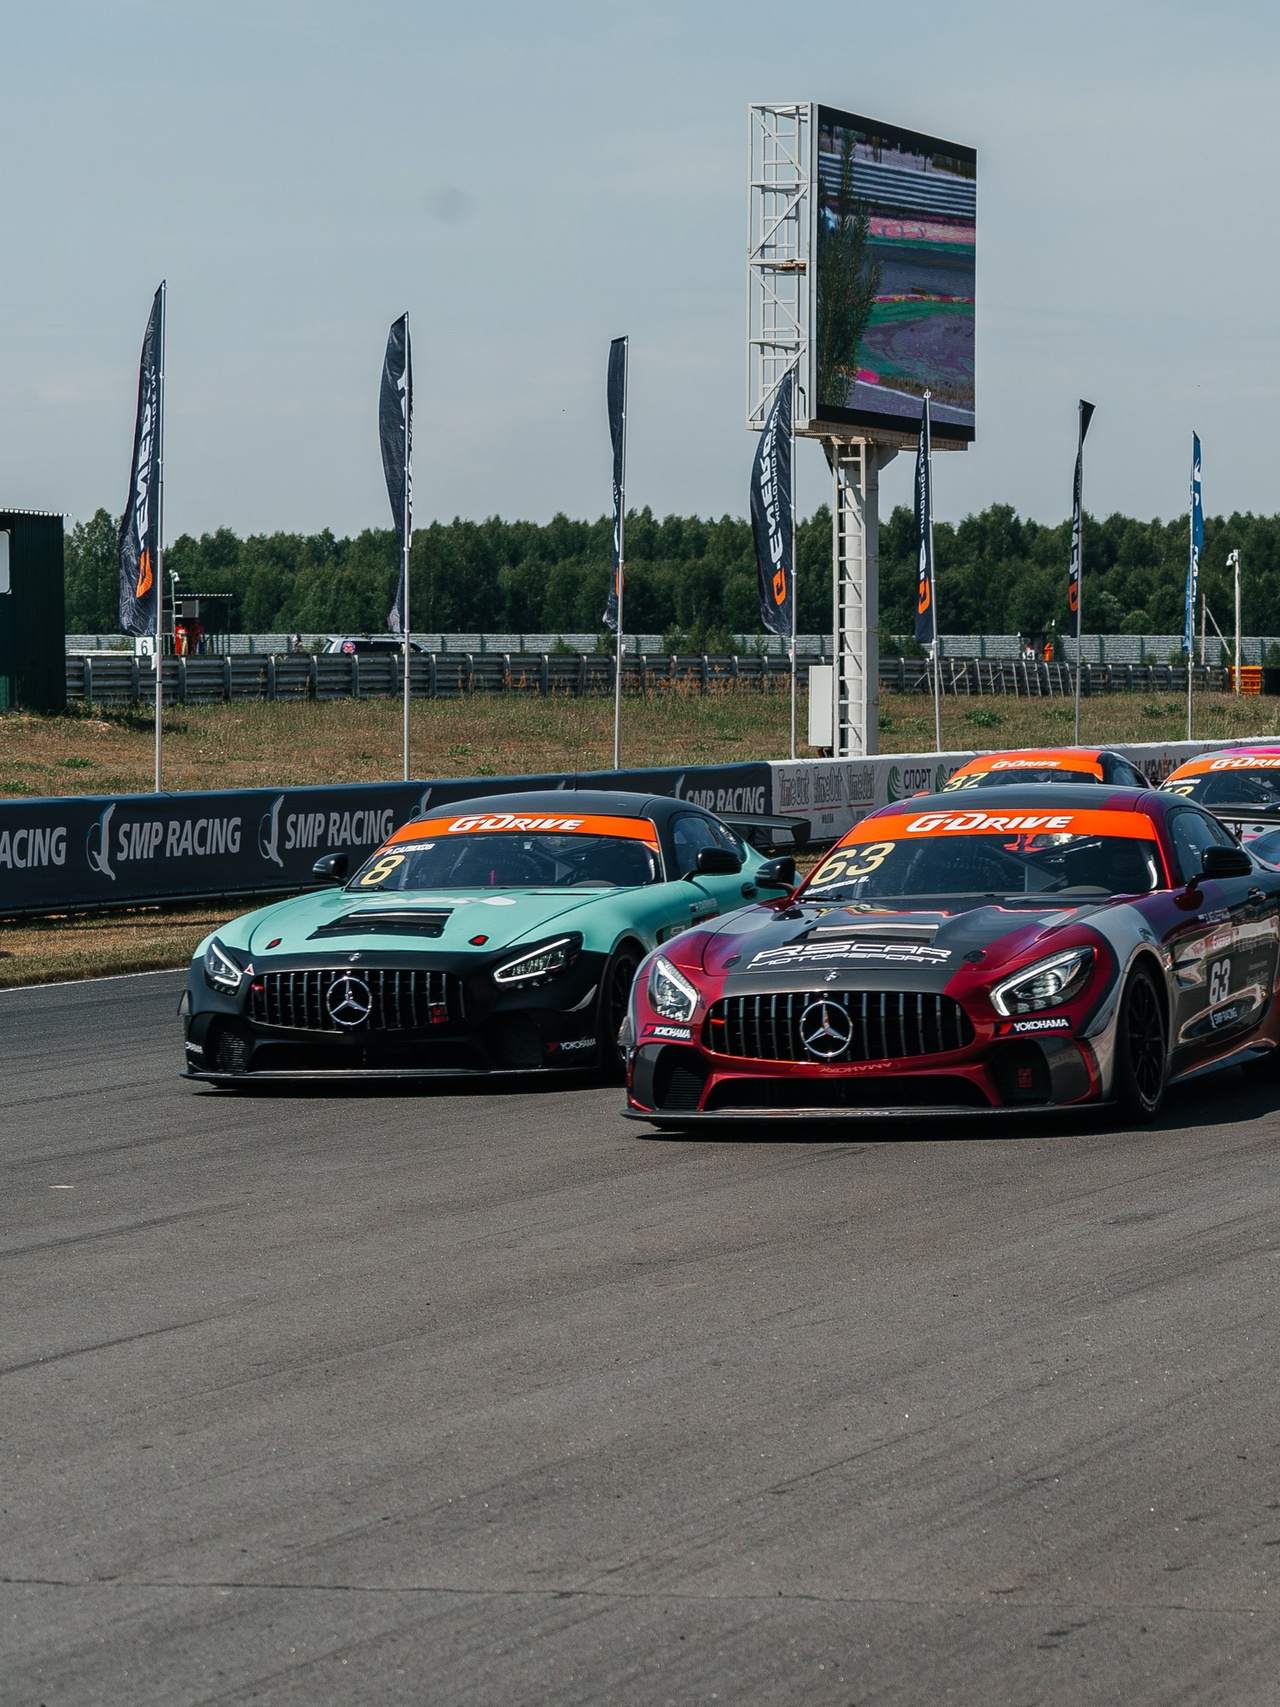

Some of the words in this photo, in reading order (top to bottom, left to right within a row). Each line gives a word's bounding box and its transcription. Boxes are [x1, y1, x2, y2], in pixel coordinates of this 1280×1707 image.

[140, 640, 149, 656] 6
[903, 768, 932, 791] СПОРТ
[716, 786, 766, 814] RACING
[117, 821, 163, 861] SMP
[166, 817, 242, 857] RACING
[285, 812, 324, 849] SMP
[327, 809, 394, 847] RACING
[0, 826, 67, 869] ACING
[360, 854, 406, 886] 8
[809, 842, 897, 886] 63
[746, 952, 948, 969] MOTORSPORT
[1209, 958, 1231, 1005] 63
[653, 1026, 691, 1039] YOKOHAMA
[1013, 1018, 1069, 1032] YOKOHAMA
[560, 1038, 596, 1050] YOKOHAMA
